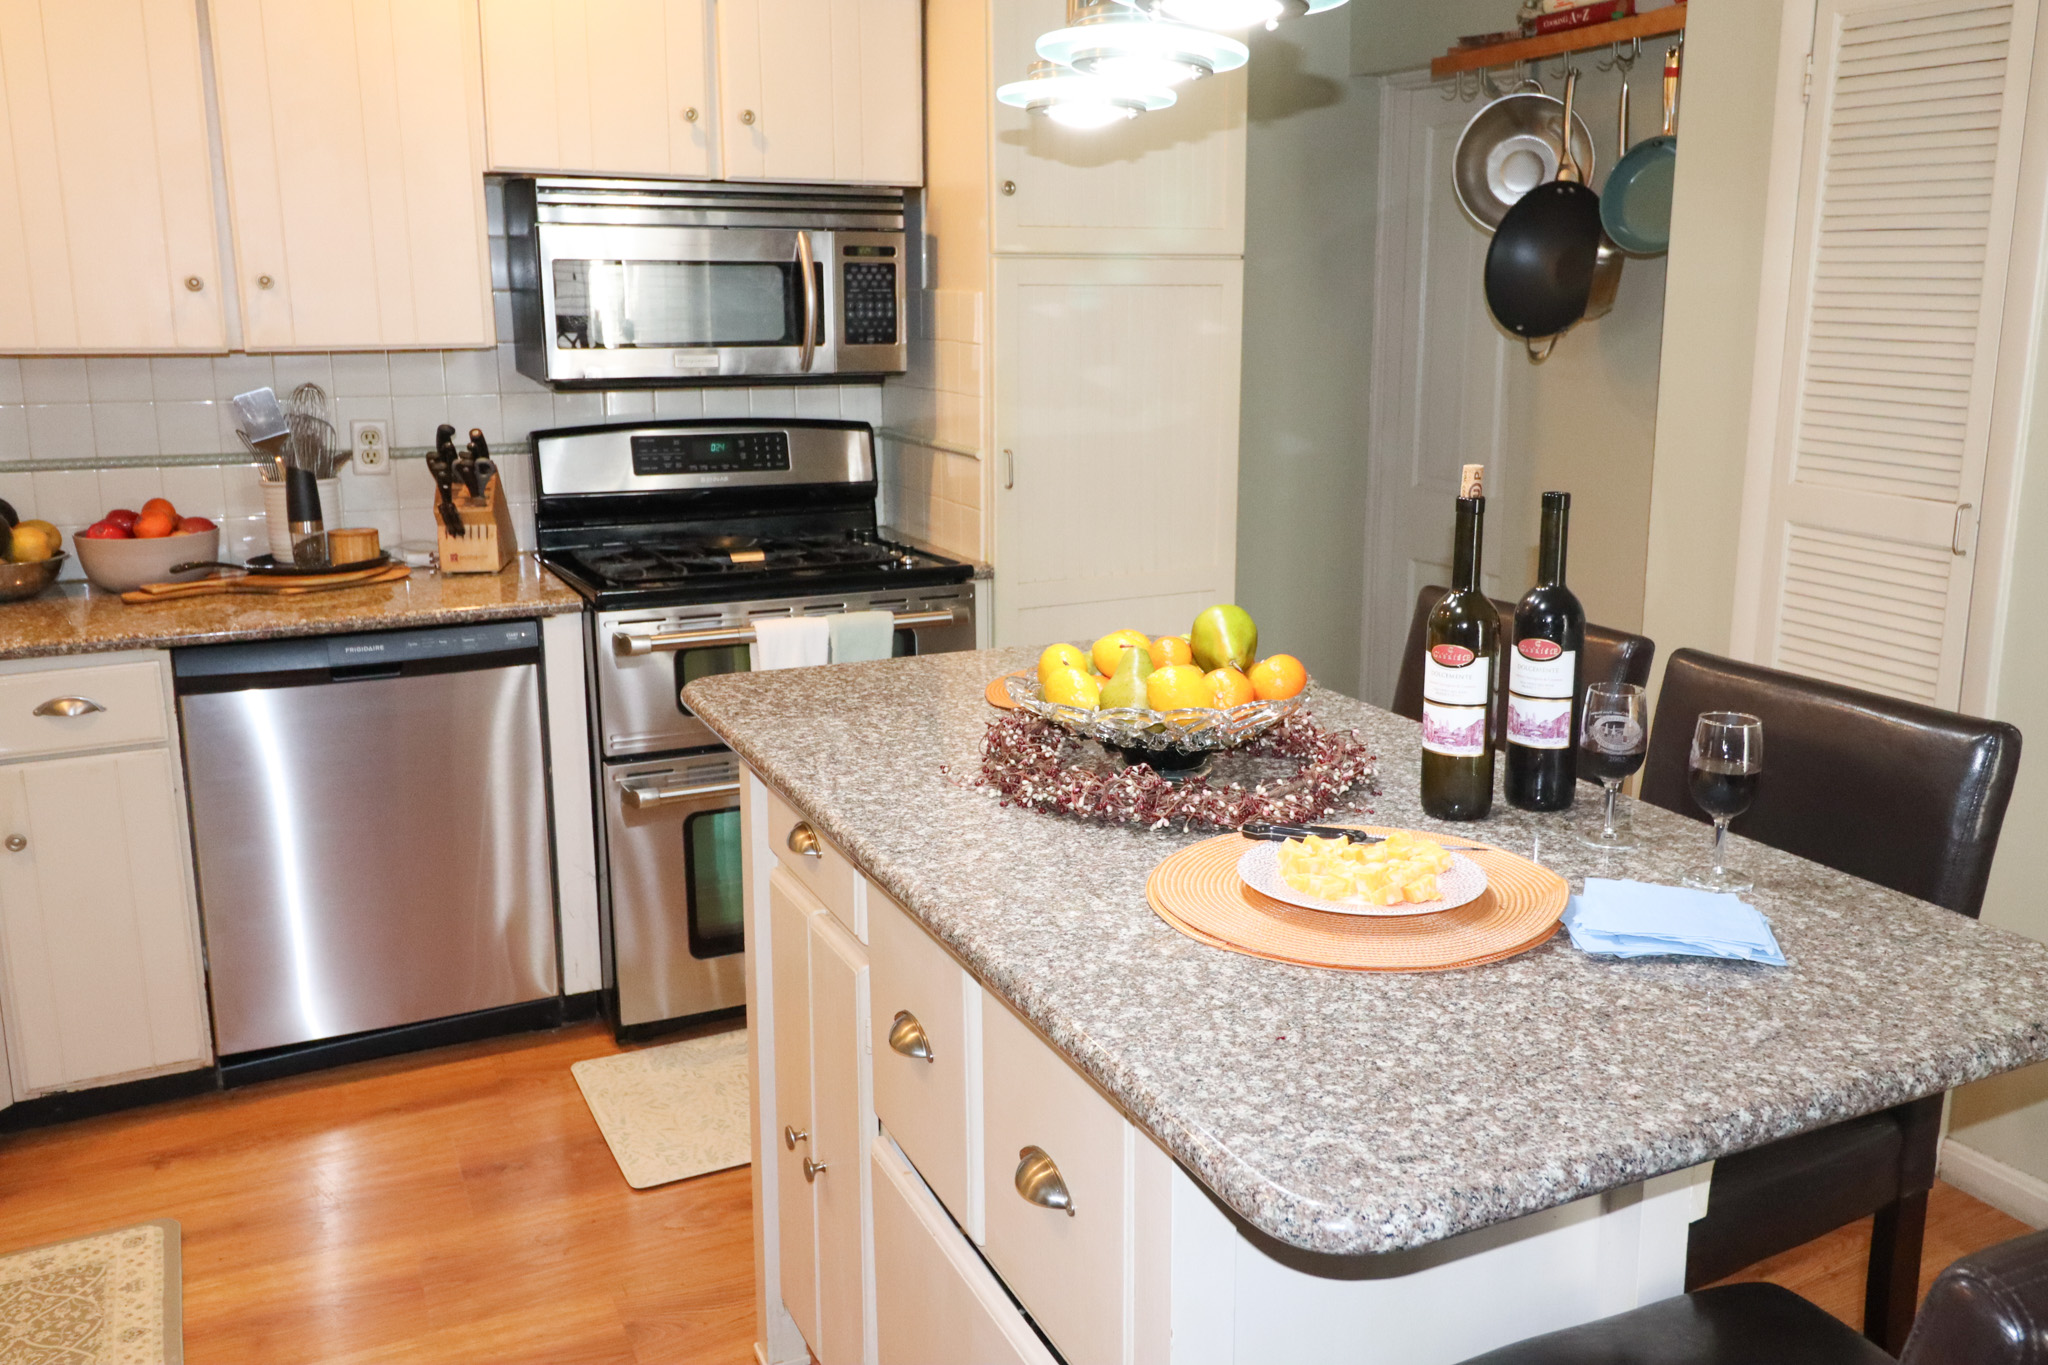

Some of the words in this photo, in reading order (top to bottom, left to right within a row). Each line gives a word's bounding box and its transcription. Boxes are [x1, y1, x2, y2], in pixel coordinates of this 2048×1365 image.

[1582, 8, 1590, 21] Z
[345, 645, 385, 653] FRIGIDAIRE
[1517, 663, 1560, 673] DOLCEMENTE
[1432, 670, 1472, 680] DOLCEMENTE
